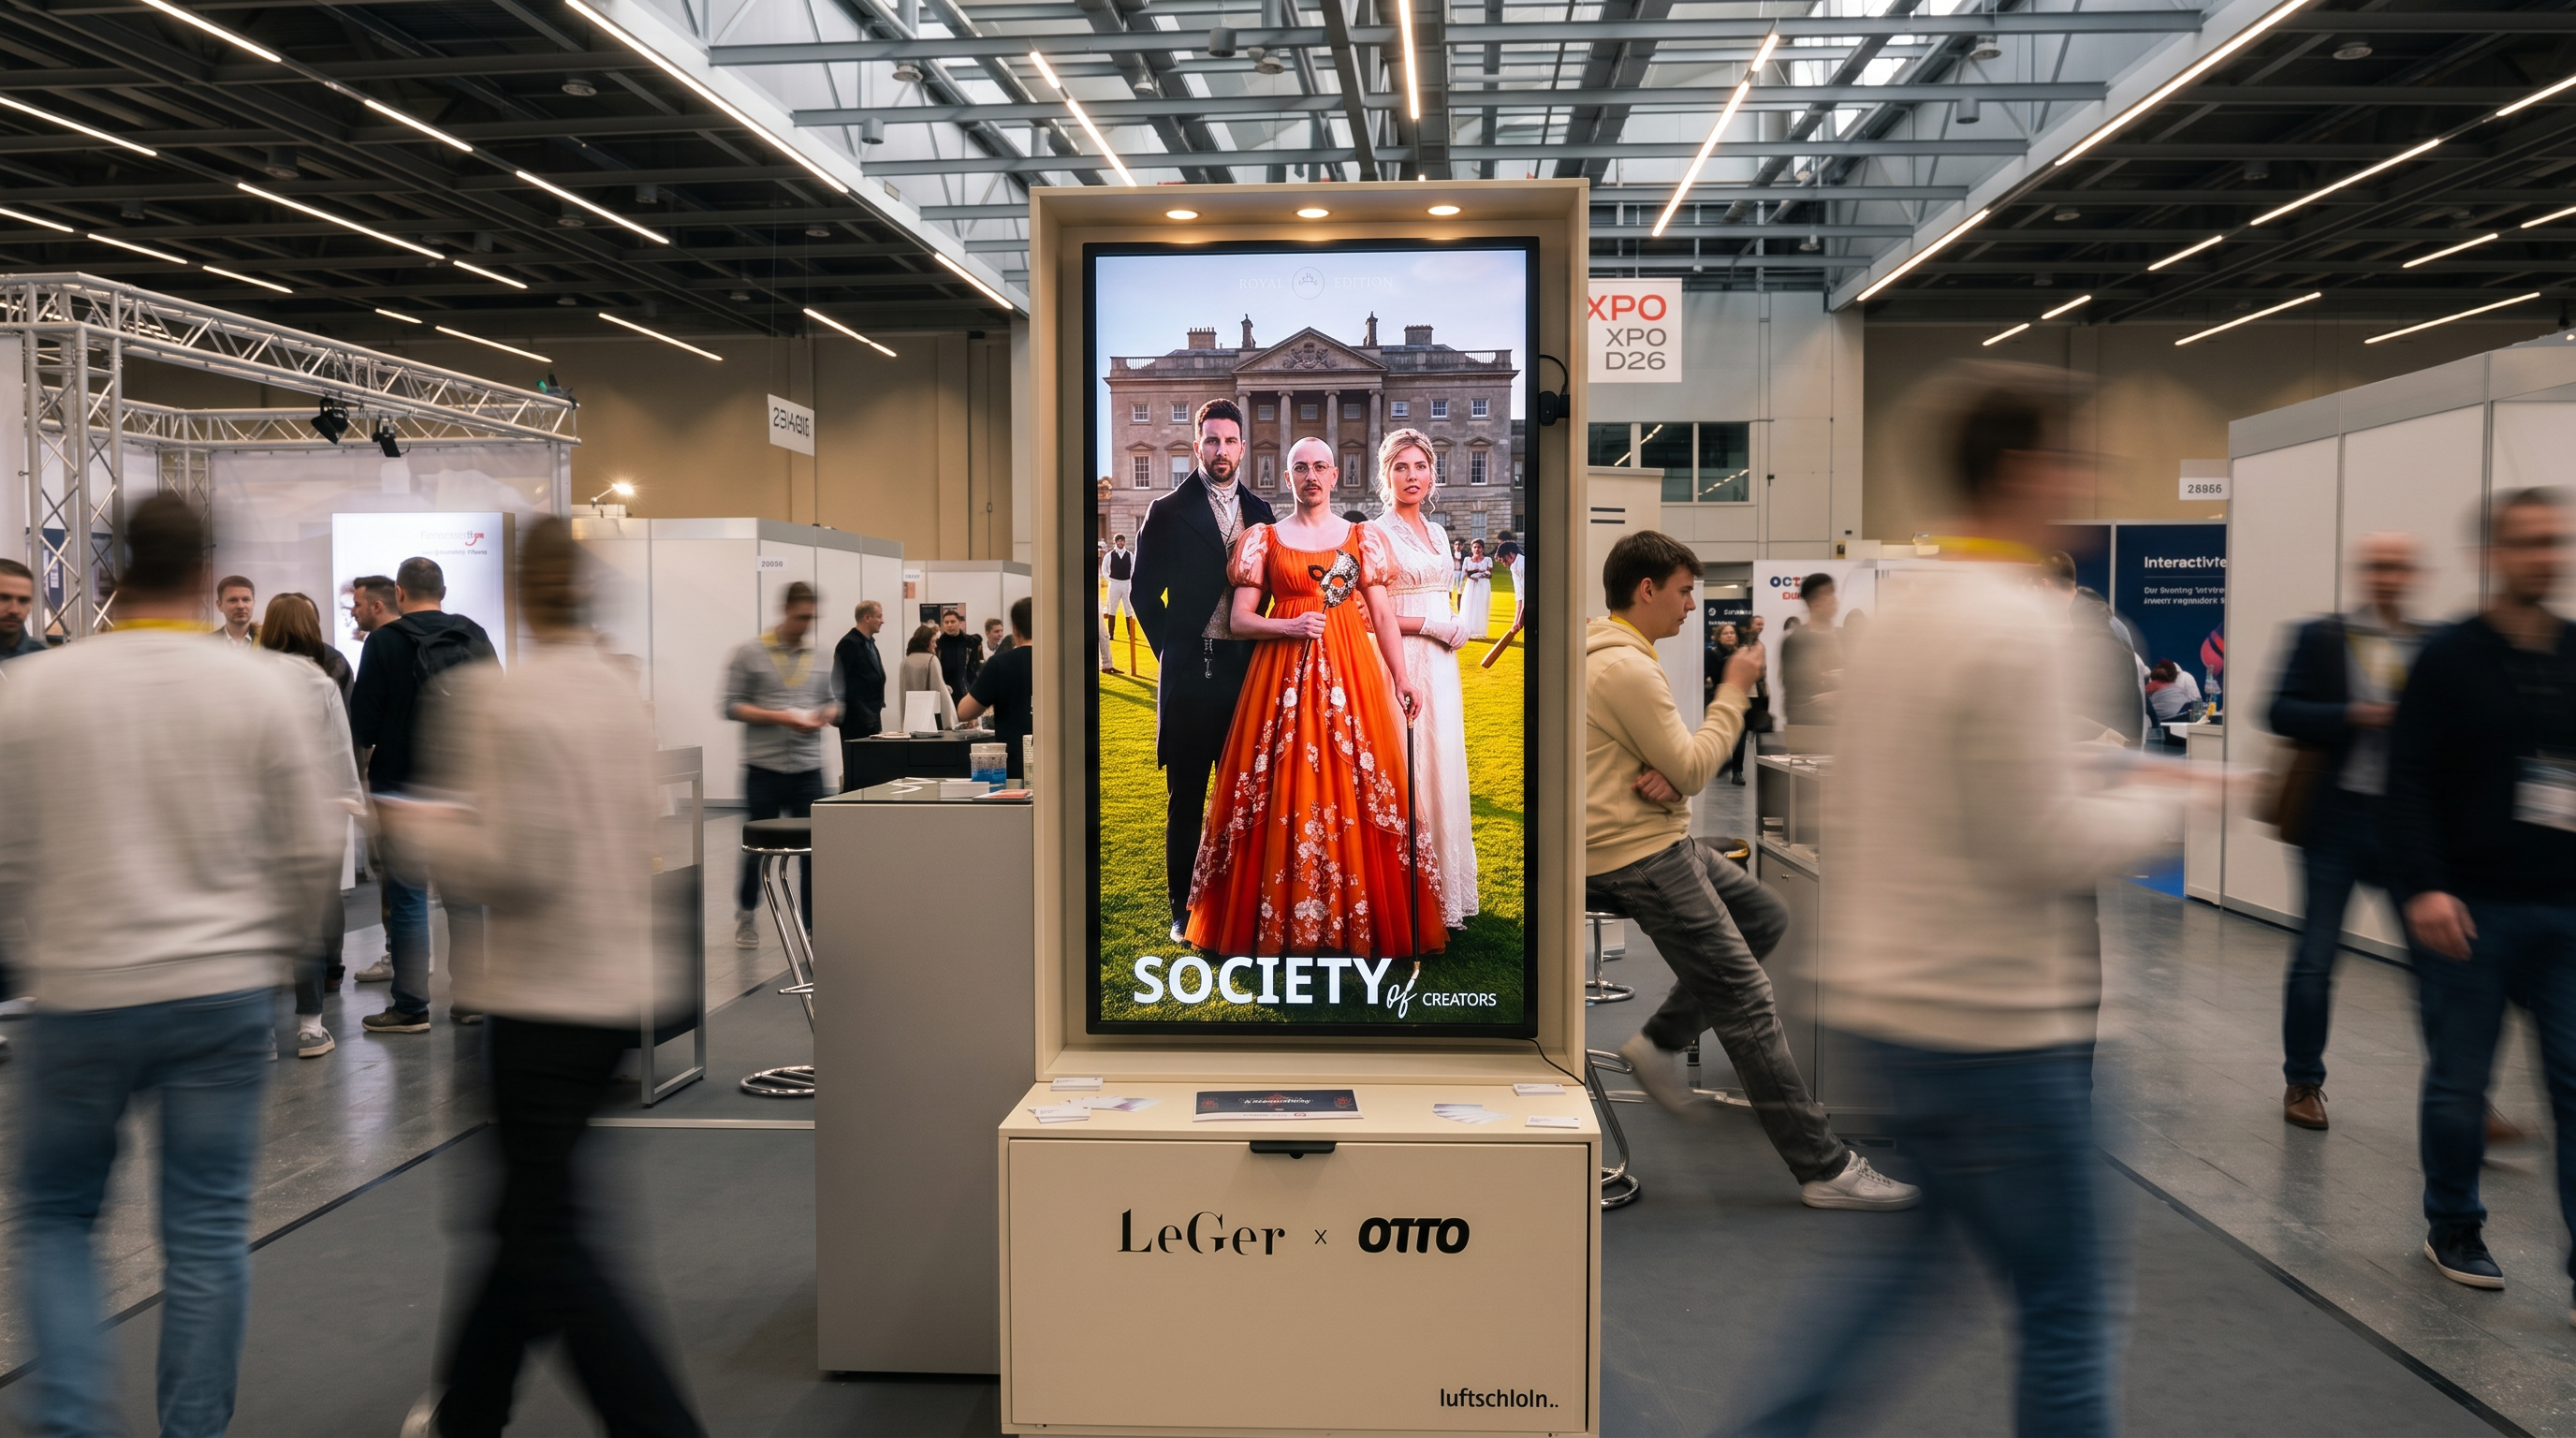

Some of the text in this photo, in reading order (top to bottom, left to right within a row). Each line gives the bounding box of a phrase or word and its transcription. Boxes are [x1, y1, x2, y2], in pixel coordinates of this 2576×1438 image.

[1239, 277, 1393, 289] ROYAL EDITION
[1588, 294, 1667, 321] XPO
[1605, 328, 1667, 347] XPO
[1605, 351, 1666, 370] D26
[1133, 955, 1497, 1020] SOCIETY of CREATORS
[1117, 1208, 1286, 1256] LeGer
[1357, 1216, 1471, 1255] OTTO
